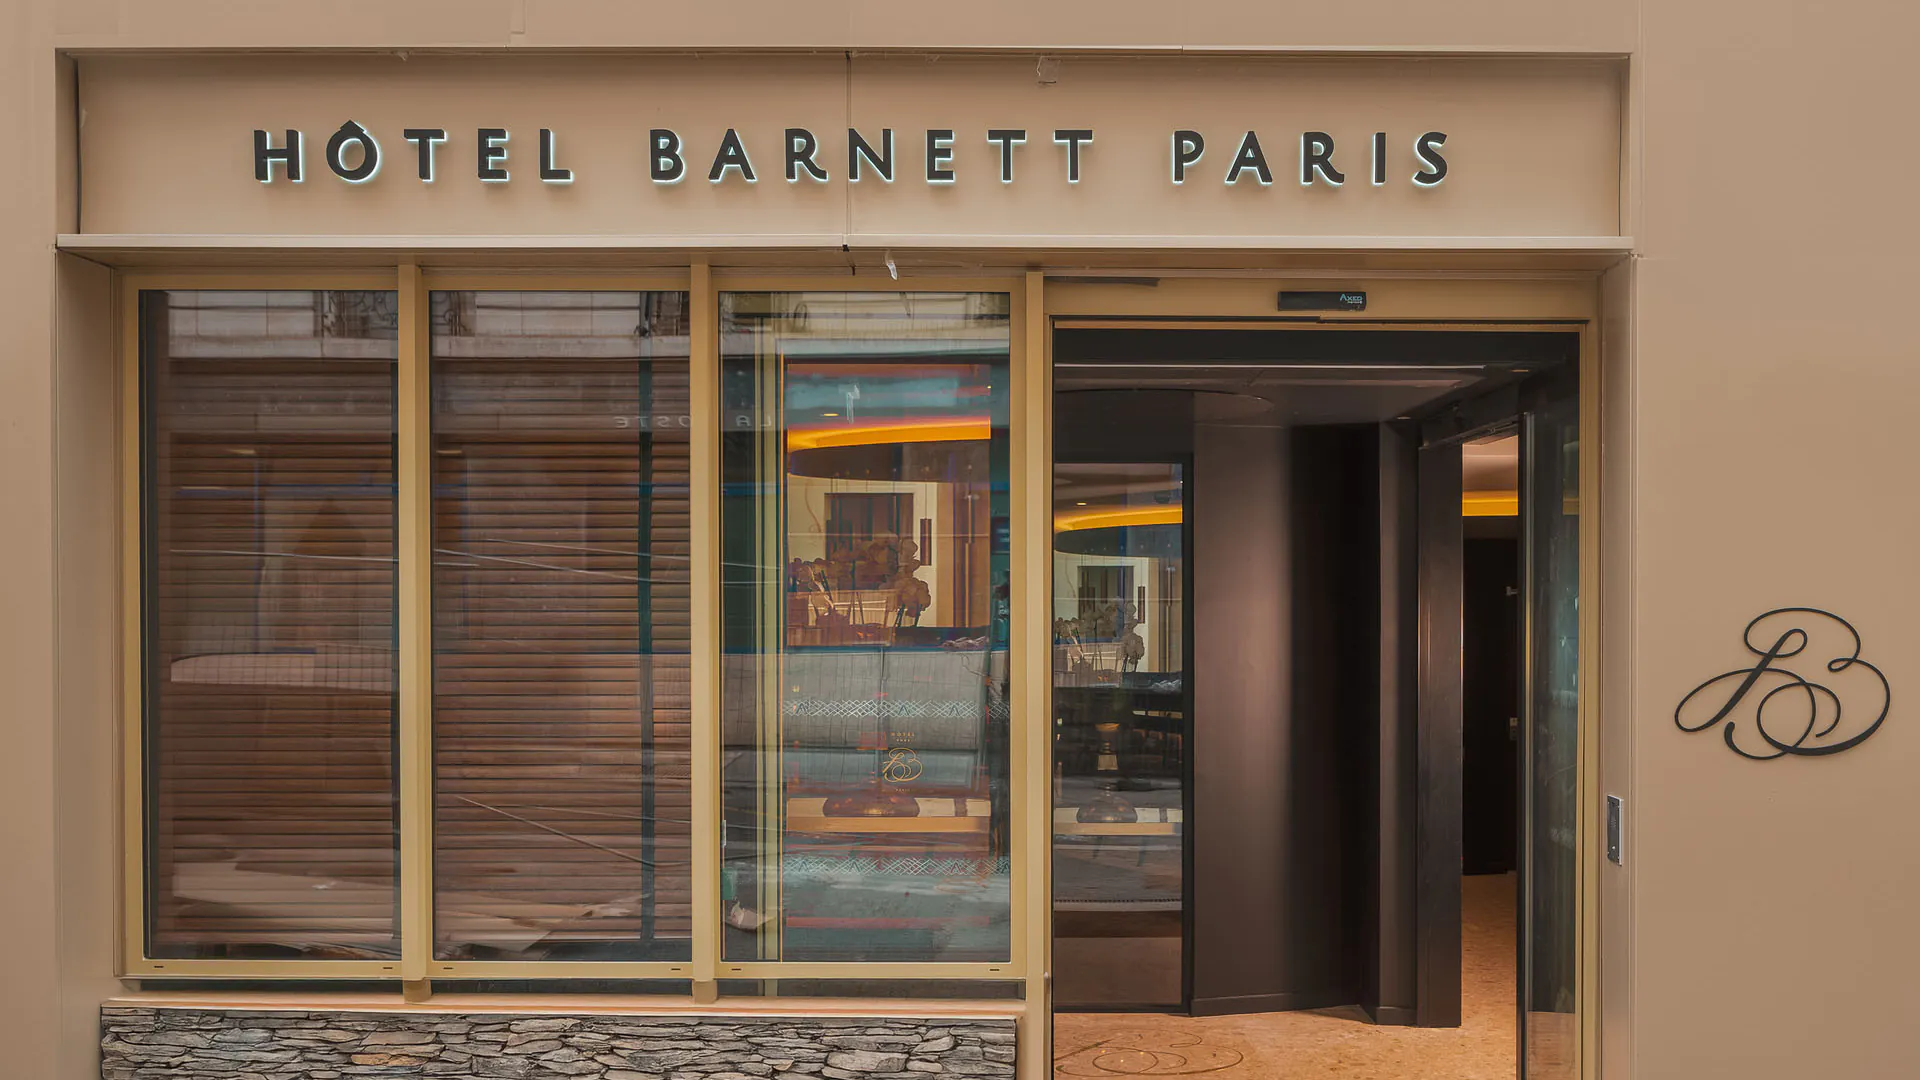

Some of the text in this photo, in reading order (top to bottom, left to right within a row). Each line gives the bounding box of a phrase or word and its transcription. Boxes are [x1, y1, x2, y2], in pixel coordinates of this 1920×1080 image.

[253, 119, 1450, 186] HÔTEL BARNETT PARIS
